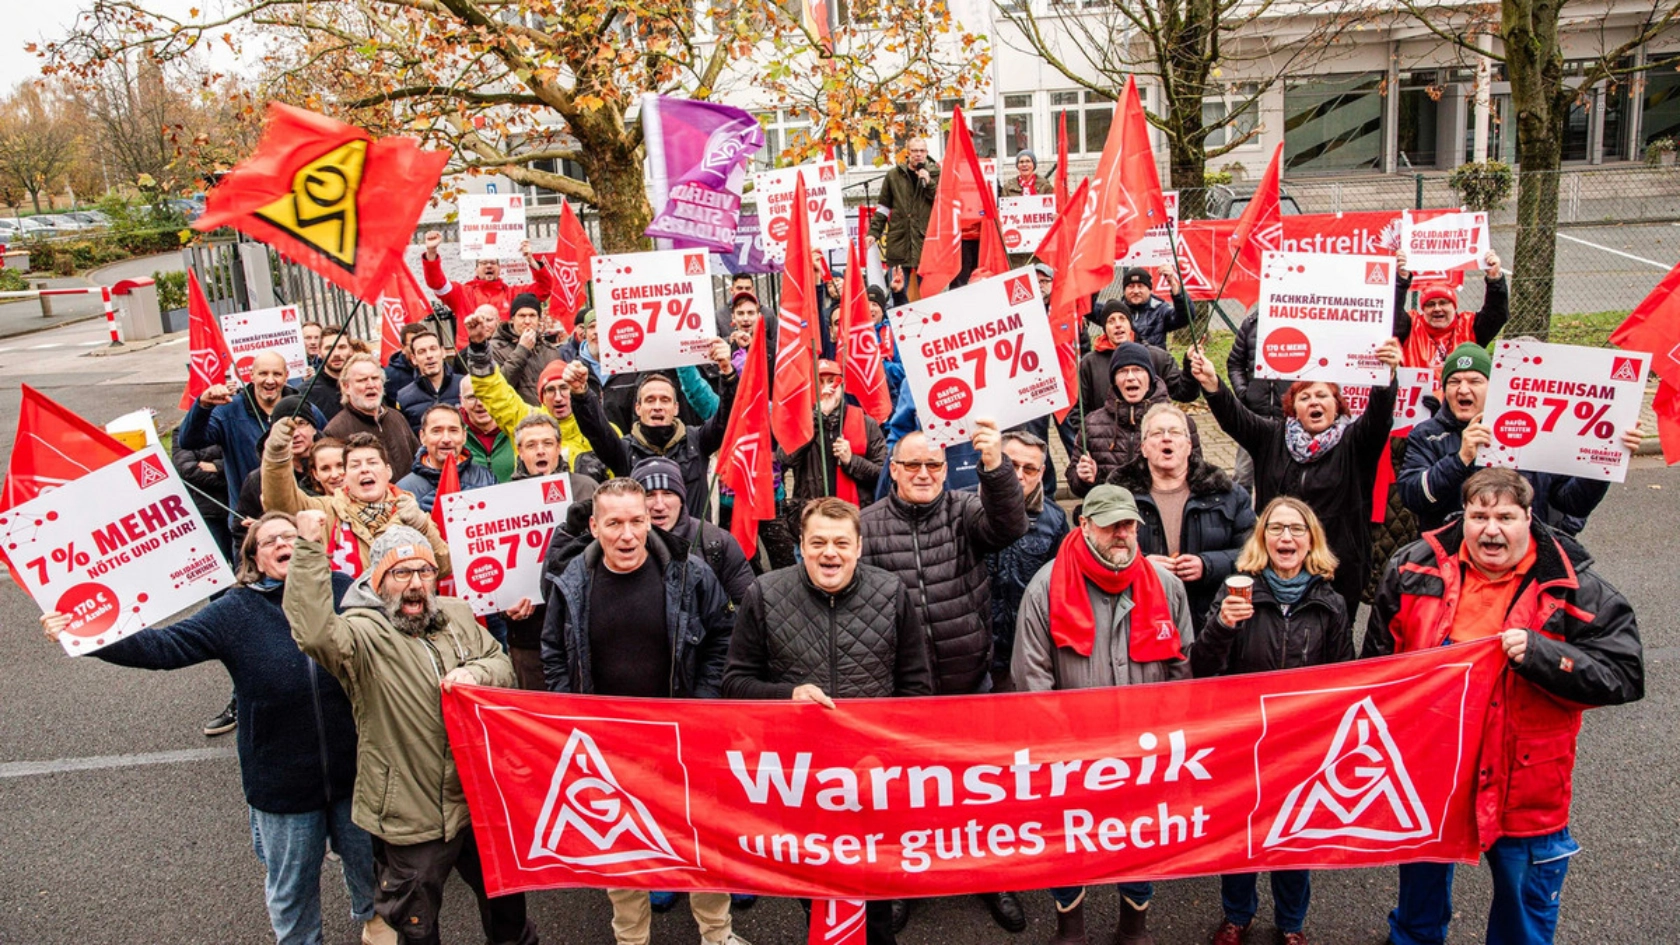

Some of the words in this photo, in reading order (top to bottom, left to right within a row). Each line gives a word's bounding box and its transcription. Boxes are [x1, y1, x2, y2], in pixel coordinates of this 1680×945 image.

[767, 186, 827, 205] GEMESAM
[769, 204, 788, 215] FÜR
[1002, 214, 1020, 225] 7%
[1023, 212, 1054, 224] MEHR
[1283, 229, 1377, 254] nstreik
[1411, 228, 1469, 238] SOLIDARITÄT
[611, 281, 694, 300] GEMEINSAM
[612, 301, 638, 316] FÜR
[1270, 293, 1384, 309] FACHKRÄFTEMANGEL?!
[1269, 305, 1383, 323] HAUSGEMACHT!
[232, 336, 298, 353] HAUSGEMACHT!
[921, 313, 1024, 358] GEMEINSAM
[926, 356, 960, 377] FÜR
[1457, 358, 1471, 367] 96
[936, 385, 960, 399] DAFÜR
[1018, 377, 1057, 396] SOLIDARITÄT
[1030, 383, 1058, 398] GEWINNT
[1342, 386, 1408, 397] SOLIDÄT
[1509, 377, 1615, 400] GEMEINSAM
[935, 391, 967, 408] STREITEN
[1506, 392, 1538, 408] FÜR
[1579, 447, 1623, 457] SOLIDARITÄT
[1590, 455, 1621, 464] GEWINNT
[465, 510, 554, 539] GEMEINSAM
[26, 541, 90, 586] 7%
[91, 494, 190, 556] MEHR
[468, 537, 496, 555] FÜR
[86, 553, 131, 579] NÖTIG
[132, 538, 161, 558] UND
[161, 520, 197, 544] FAIR!
[170, 553, 215, 581] SOLIDARITÄT
[186, 560, 218, 580] GEWINNT
[73, 598, 95, 617] 170
[86, 603, 113, 623] Azubis
[725, 729, 1215, 812] Warnstreik
[738, 831, 884, 867] unser
[901, 818, 1046, 873] gutes
[1063, 802, 1210, 853] Recht
